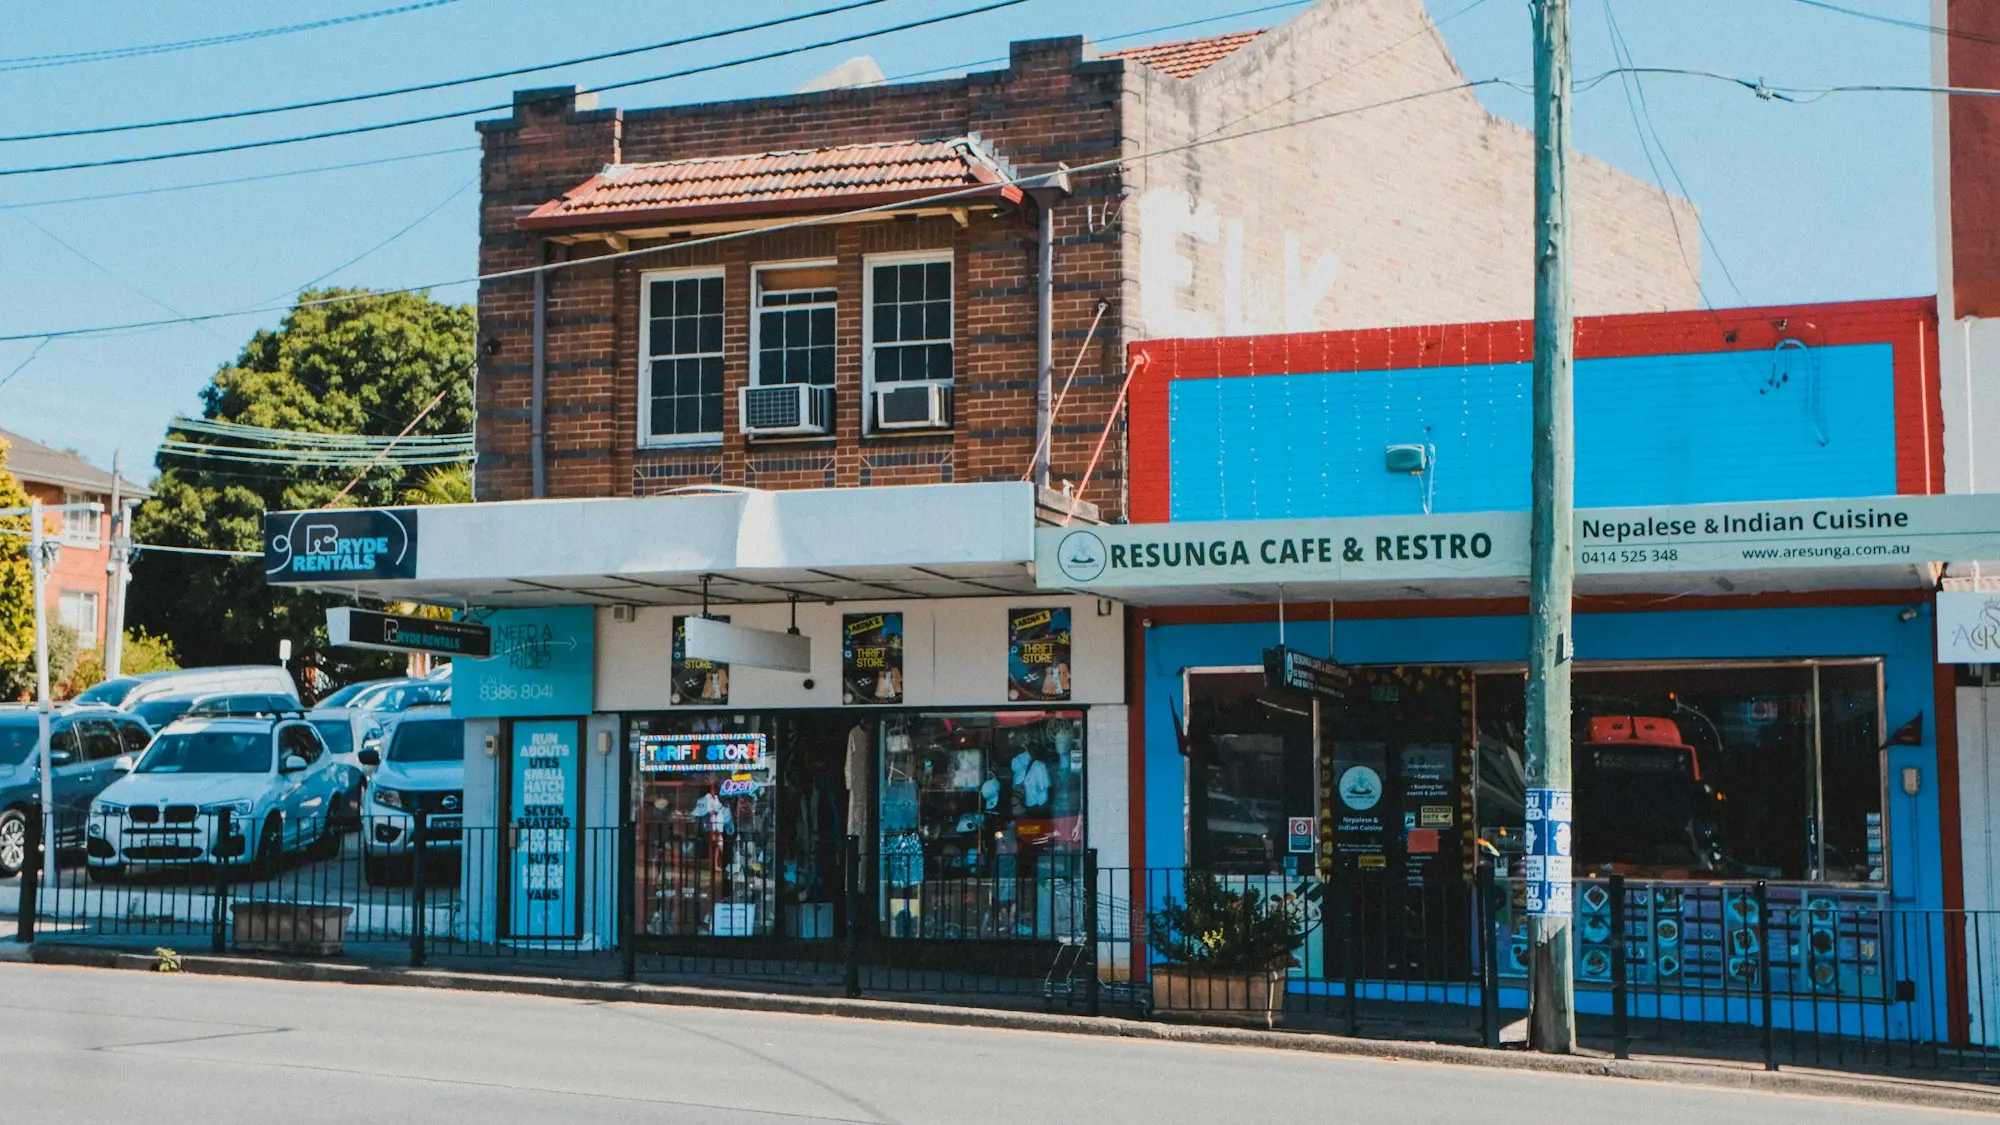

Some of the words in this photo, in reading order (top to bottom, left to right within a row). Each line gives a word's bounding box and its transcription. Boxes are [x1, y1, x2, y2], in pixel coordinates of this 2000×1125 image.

[1582, 517, 1697, 543] Nepalese
[1704, 518, 1720, 535] &
[1723, 512, 1804, 533] Indian
[1812, 508, 1909, 531] Cuisine
[338, 536, 388, 554] RYDE
[1110, 539, 1250, 569] RESUNGA
[1259, 537, 1333, 565] CAFE
[1343, 535, 1365, 562] &
[1375, 532, 1493, 561] RESTRO
[1581, 549, 1617, 565] 0414
[1621, 549, 1648, 564] 525
[1651, 548, 1679, 563] 348
[1741, 542, 1911, 560] www.aresunga.com.au
[293, 554, 376, 572] RENTALS
[498, 624, 538, 640] NEED
[542, 623, 553, 639] A
[856, 647, 886, 659] THRIFT
[1023, 643, 1053, 654] THRIFT
[856, 657, 886, 668] STORE
[1023, 653, 1053, 664] STORE
[479, 684, 518, 701] 8386
[532, 732, 558, 746] RUN
[646, 743, 701, 762] THRIFT
[705, 743, 760, 761] STORE
[529, 757, 560, 769] UTES
[723, 778, 753, 796] Open
[524, 805, 563, 817] SEVEN
[517, 817, 570, 829] SEATERS
